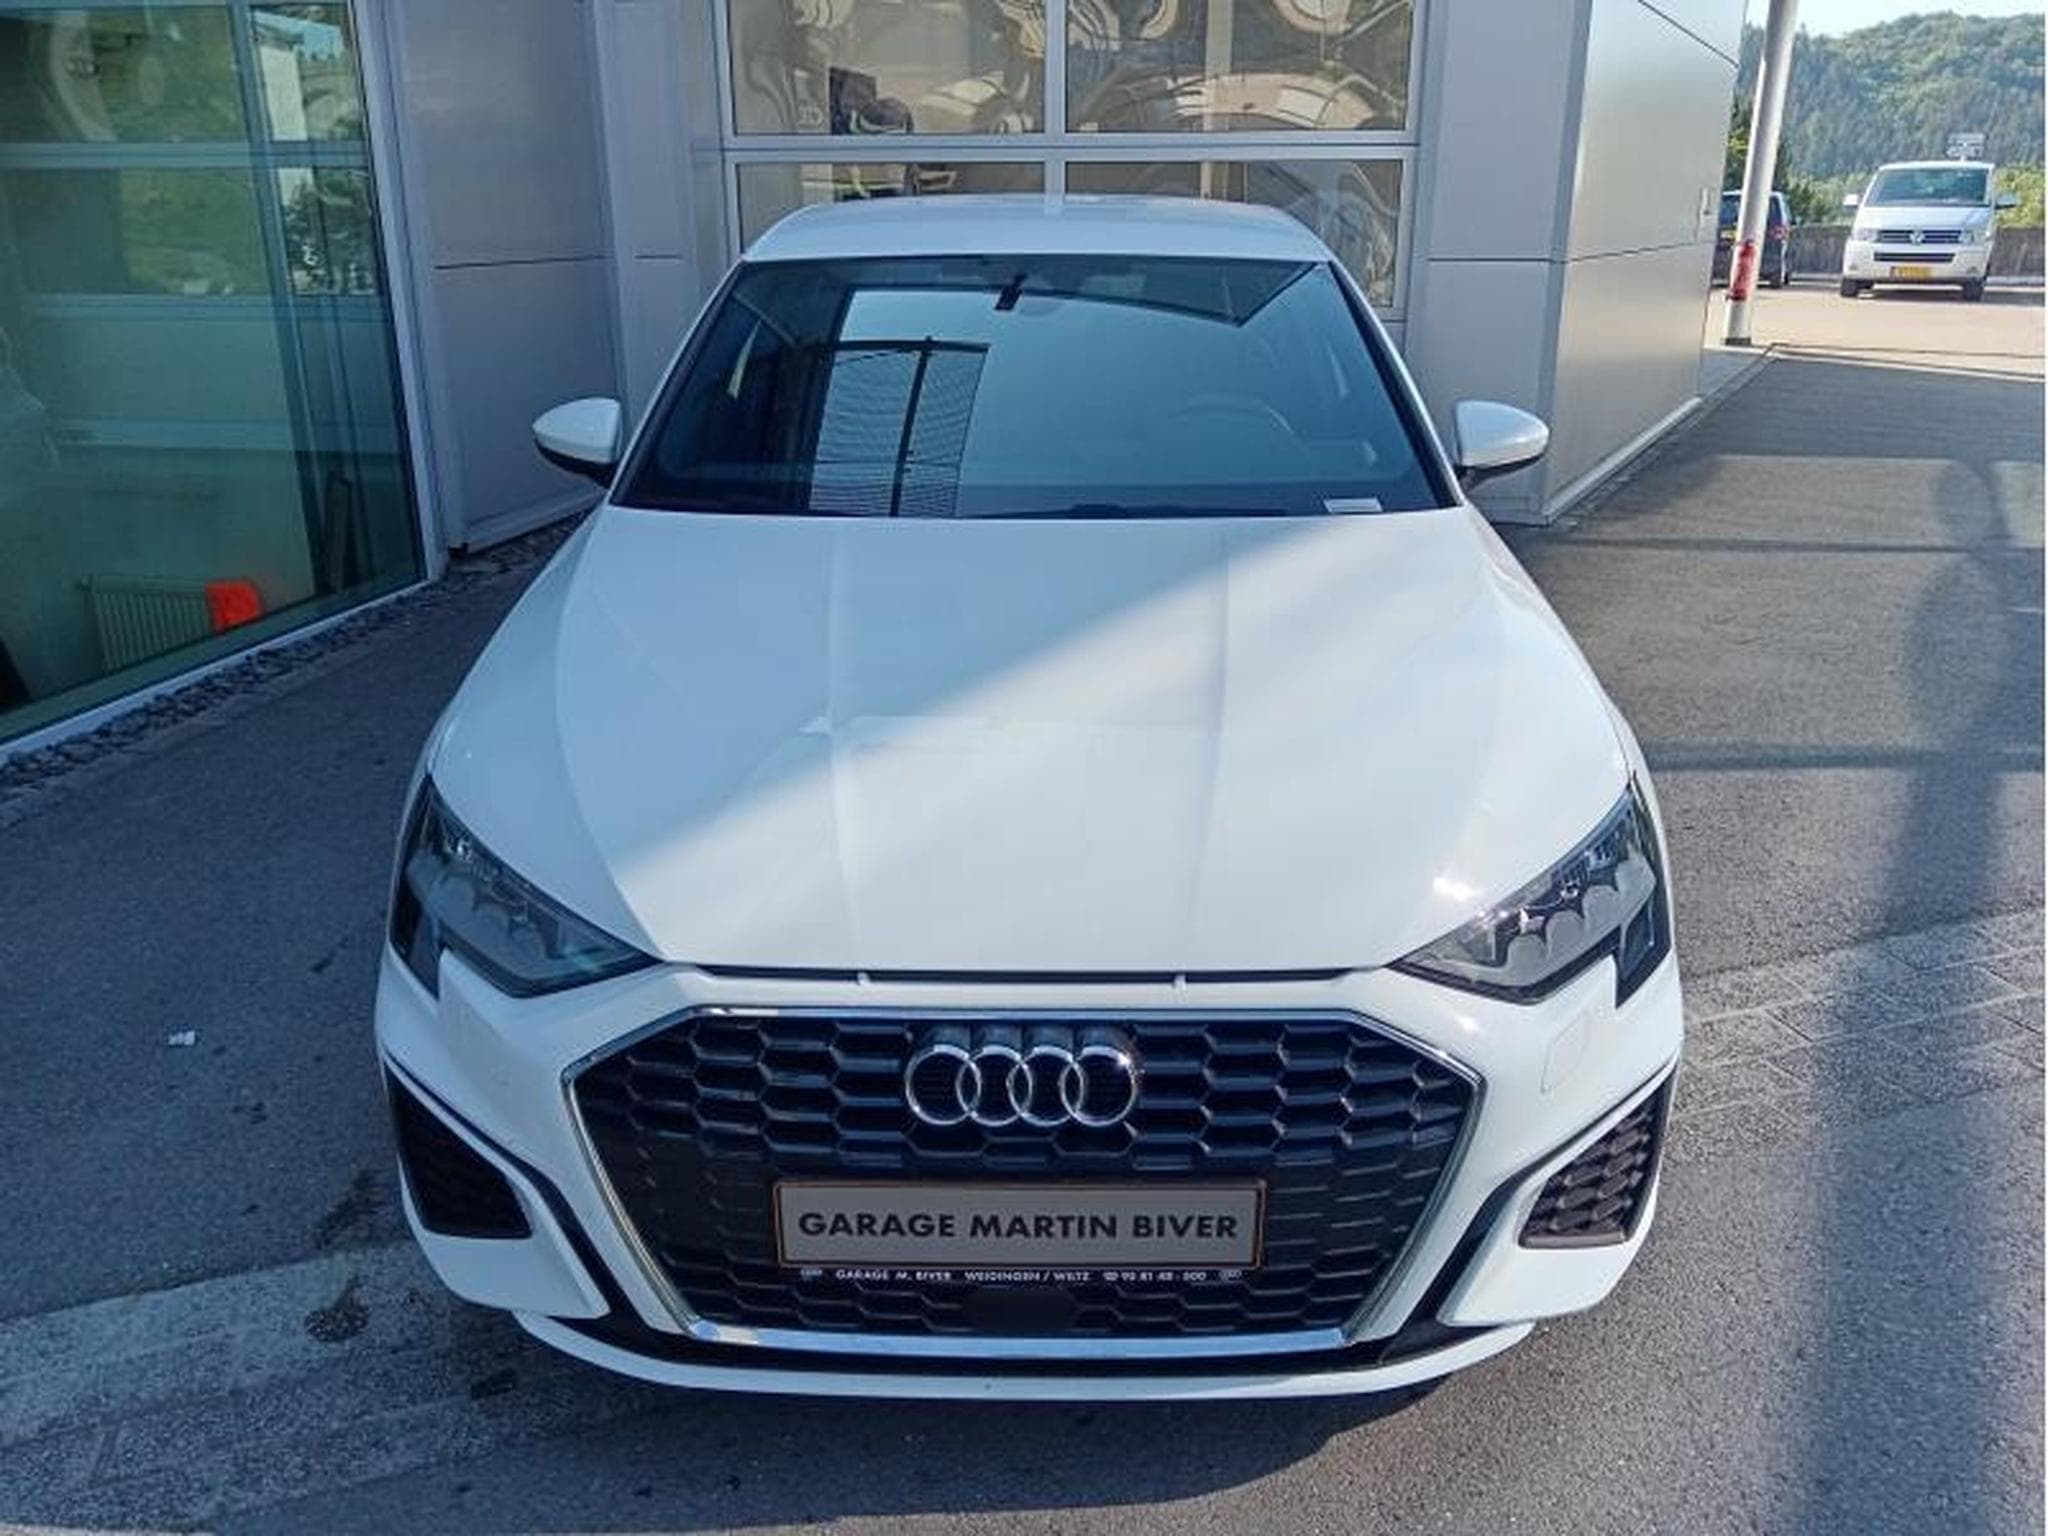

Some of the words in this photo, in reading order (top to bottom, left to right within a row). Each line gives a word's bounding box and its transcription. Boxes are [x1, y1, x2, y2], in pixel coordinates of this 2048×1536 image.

[798, 1212, 956, 1237] GARAGE
[969, 1213, 1118, 1239] MARTIN
[1132, 1214, 1239, 1239] BIVER
[836, 1269, 889, 1281] GARAGE
